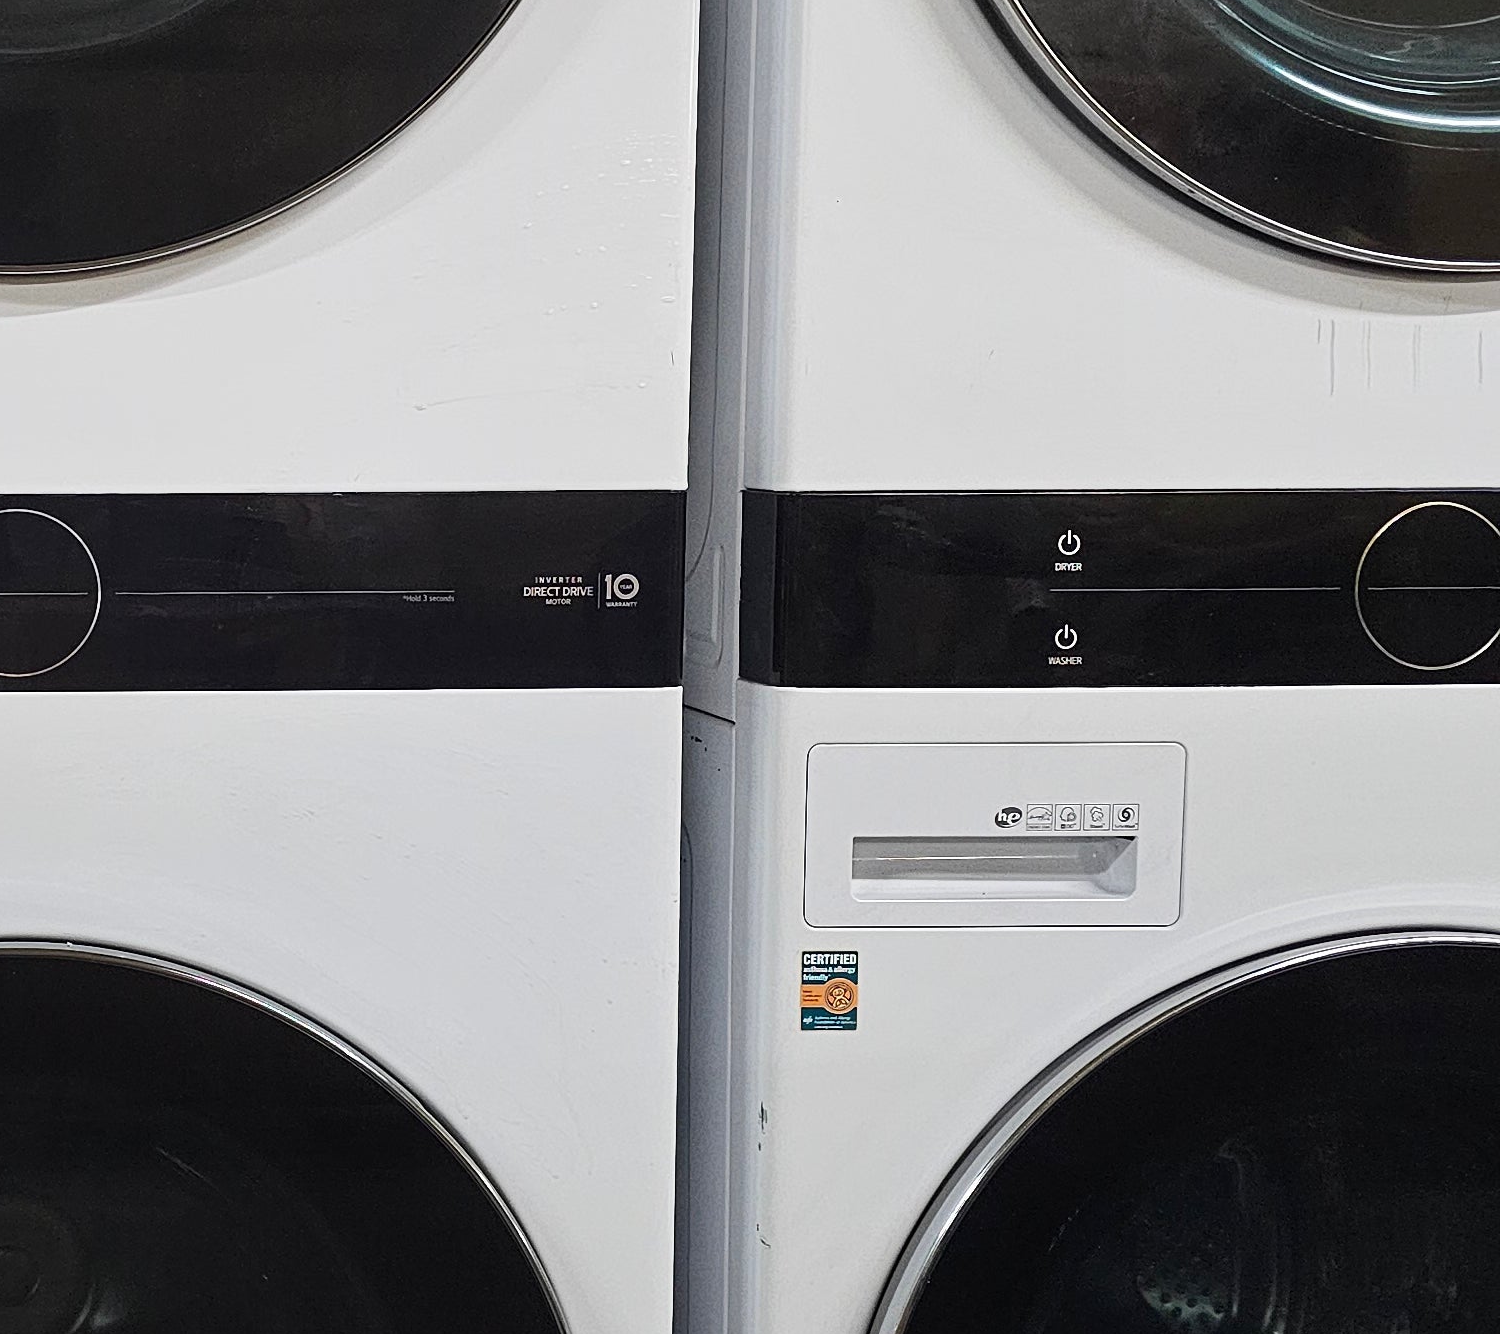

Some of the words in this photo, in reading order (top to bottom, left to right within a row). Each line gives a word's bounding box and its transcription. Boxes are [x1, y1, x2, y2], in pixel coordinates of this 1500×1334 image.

[1054, 562, 1083, 572] DRYER
[534, 576, 583, 584] INVERTER
[523, 586, 561, 597] DIRECT
[562, 586, 595, 597] DRIVE
[1048, 656, 1083, 665] WASHER
[803, 953, 857, 965] CERTIFIED
